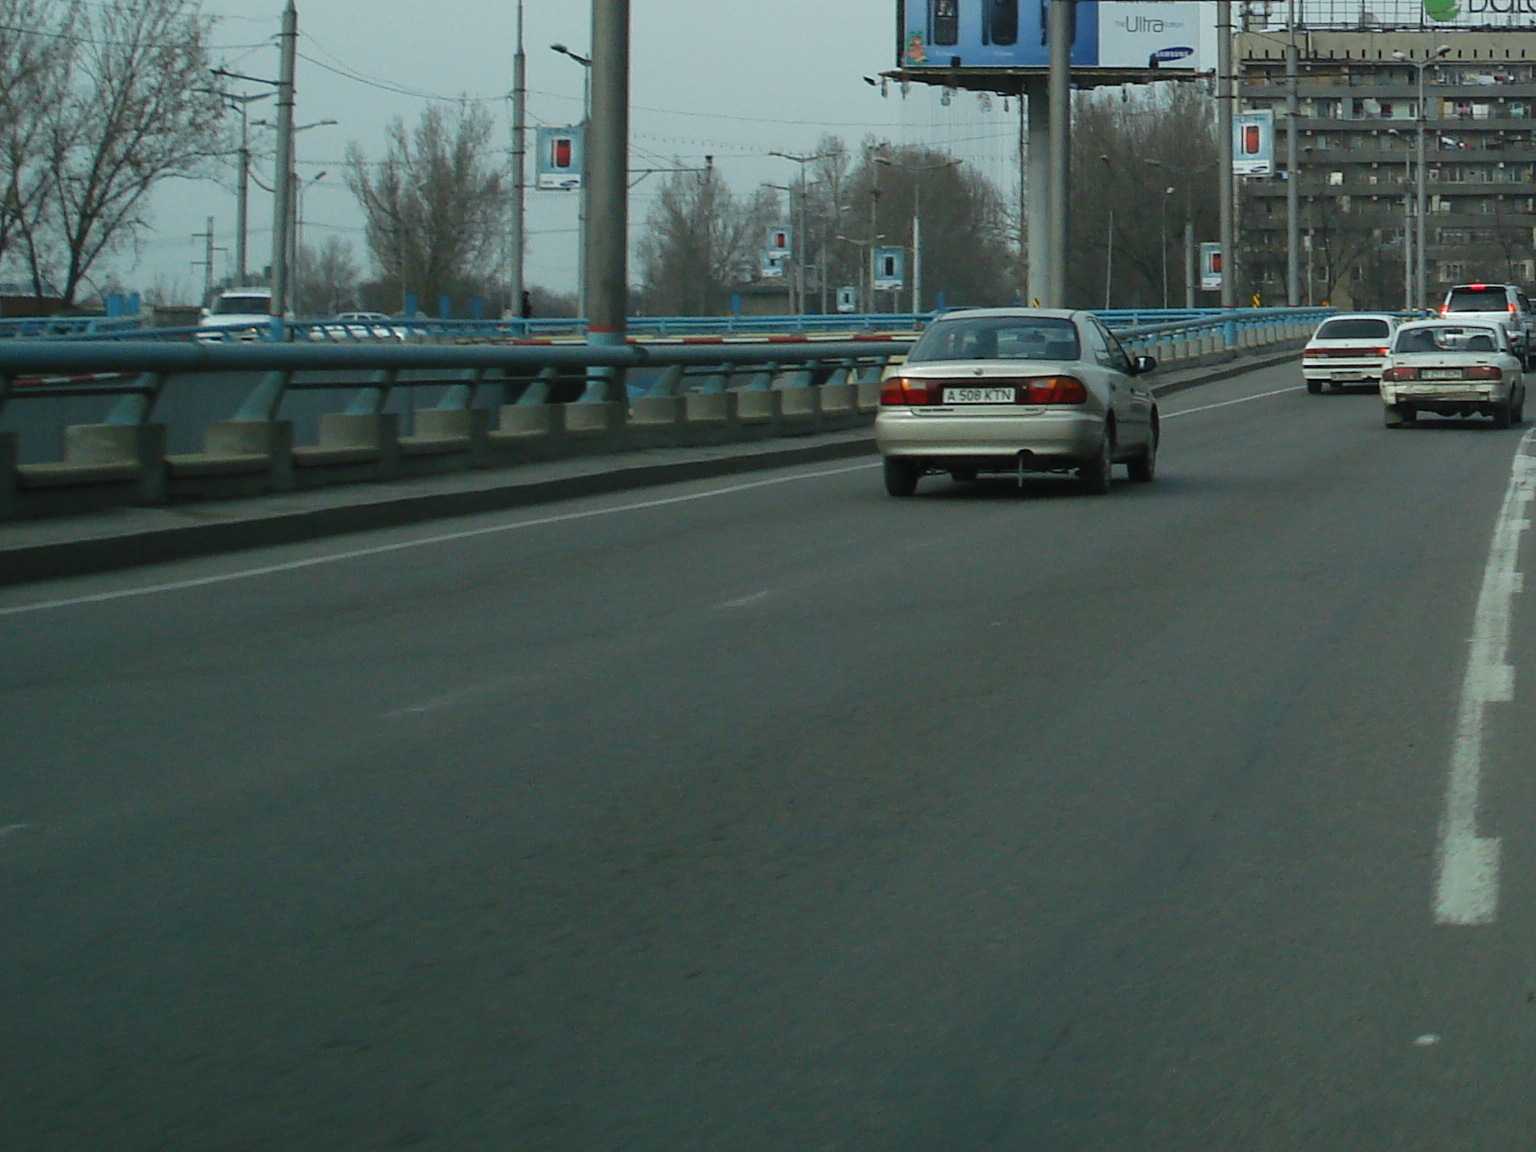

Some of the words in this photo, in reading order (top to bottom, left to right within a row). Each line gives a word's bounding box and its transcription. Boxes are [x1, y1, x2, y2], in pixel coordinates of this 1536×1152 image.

[1125, 15, 1164, 33] Ultra
[947, 391, 956, 402] A
[959, 390, 981, 402] 508
[984, 389, 1012, 401] KTN
